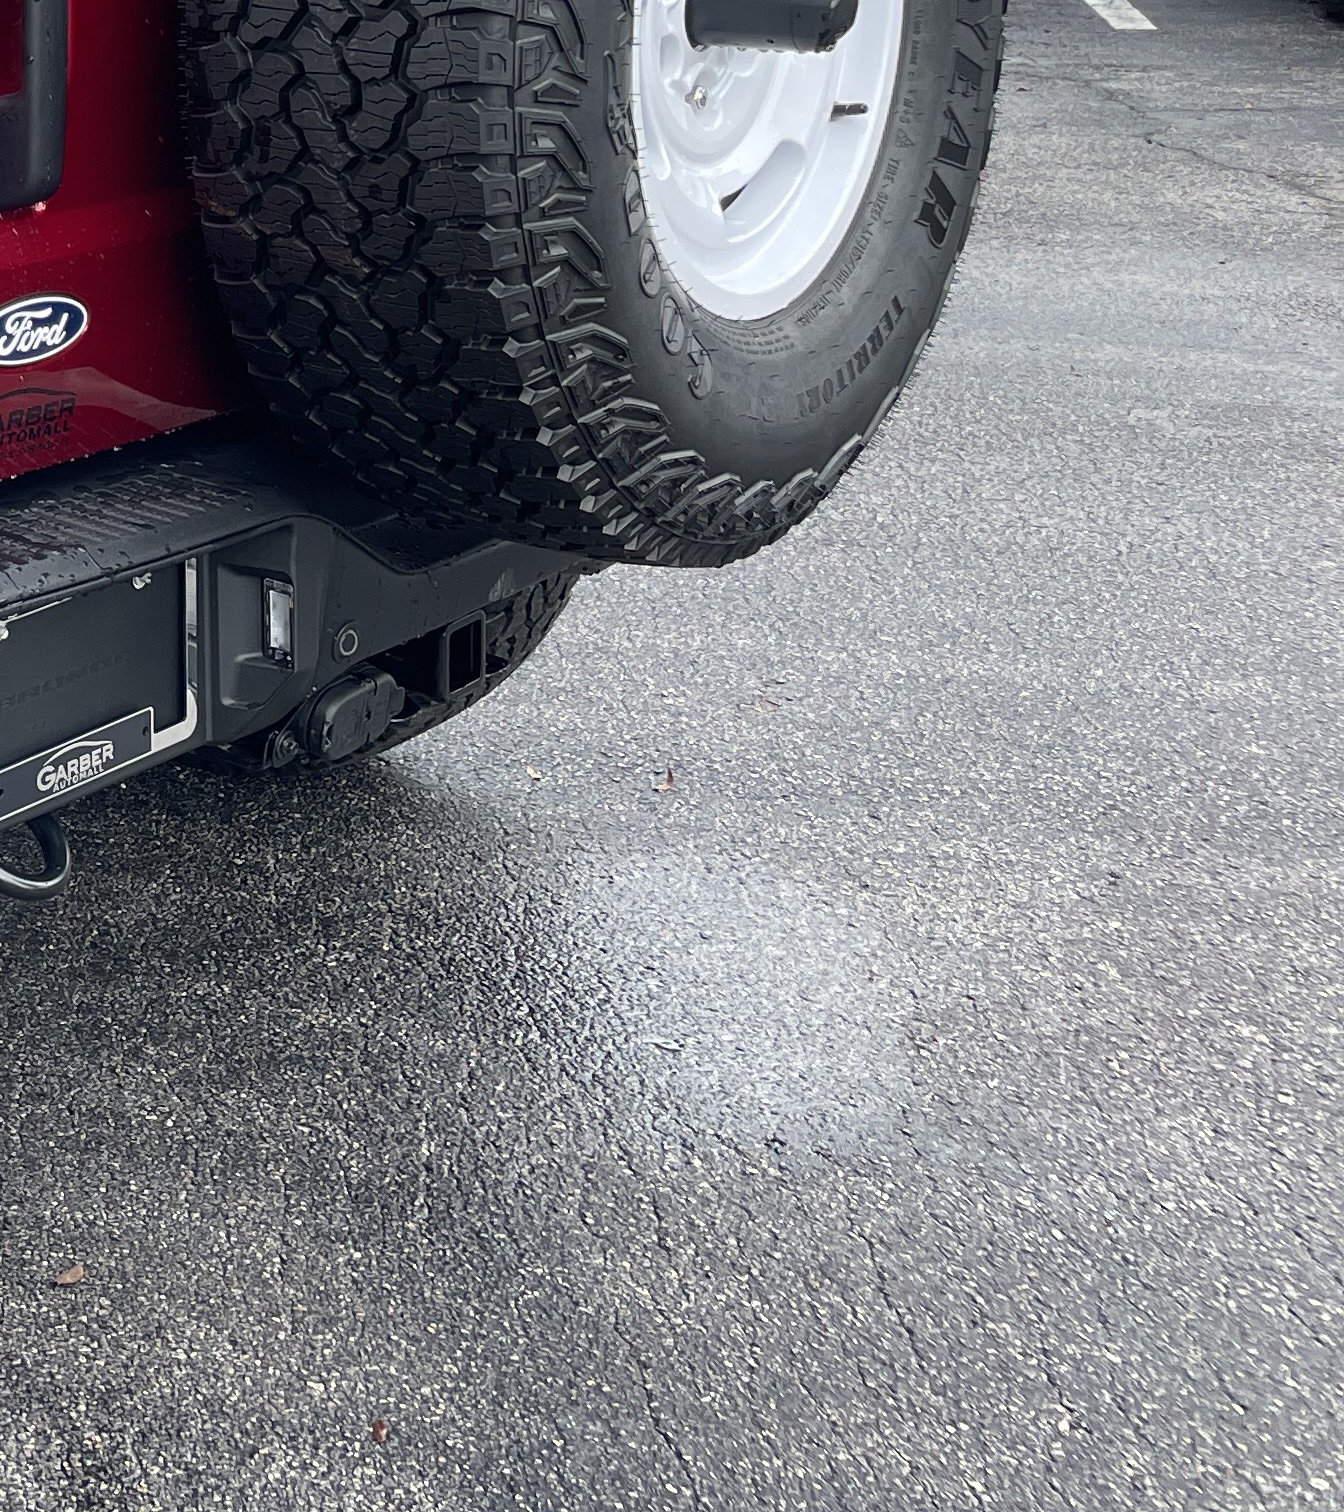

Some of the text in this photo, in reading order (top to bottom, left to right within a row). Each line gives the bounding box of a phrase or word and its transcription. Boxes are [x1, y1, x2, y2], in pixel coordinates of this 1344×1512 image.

[795, 295, 906, 417] TERRITORY
[36, 742, 115, 792] GARBER
[52, 764, 105, 793] AUTOMALL
